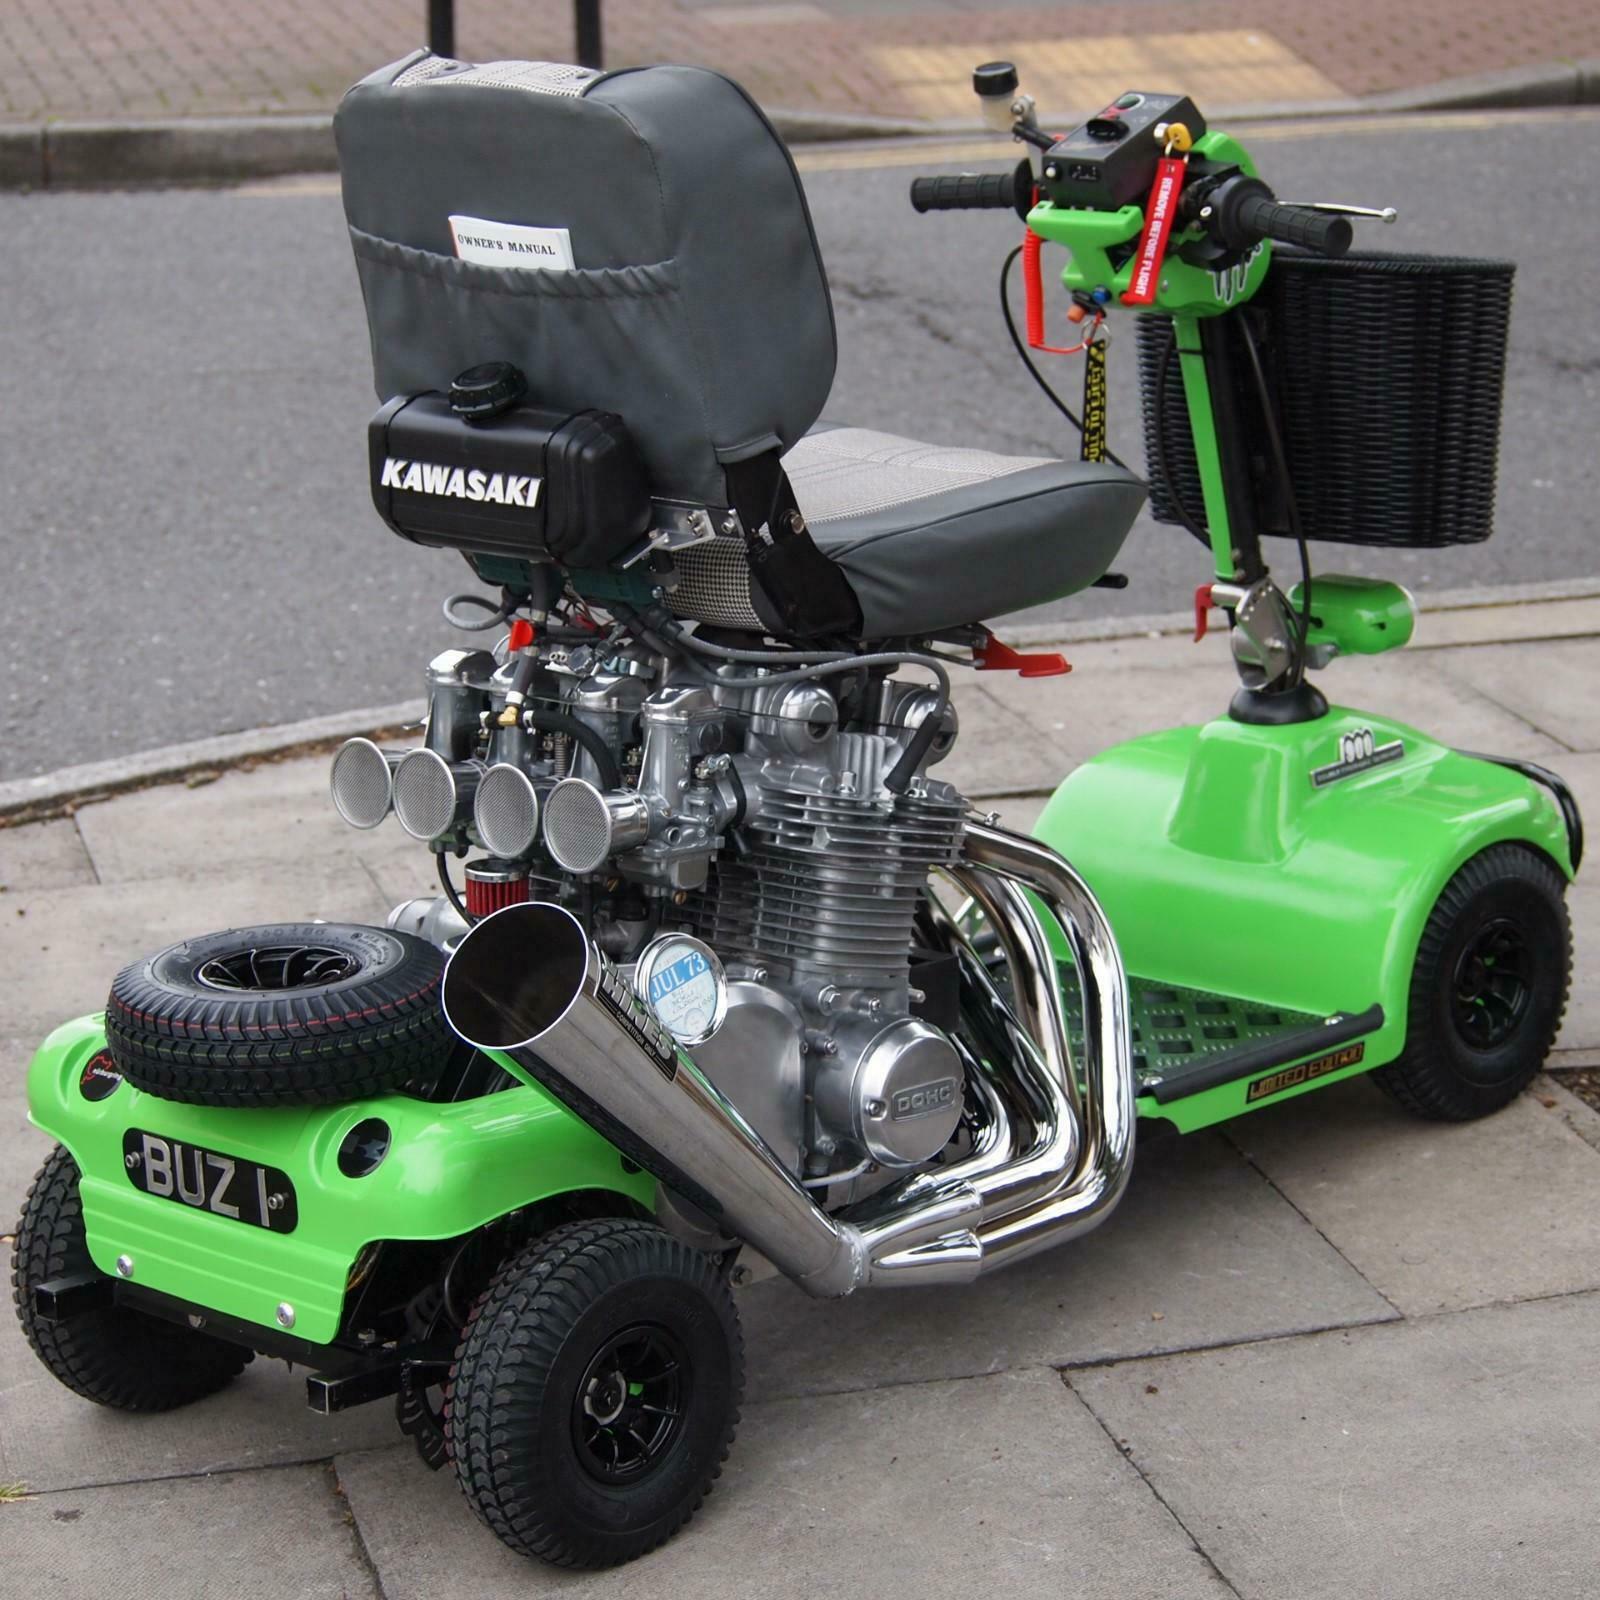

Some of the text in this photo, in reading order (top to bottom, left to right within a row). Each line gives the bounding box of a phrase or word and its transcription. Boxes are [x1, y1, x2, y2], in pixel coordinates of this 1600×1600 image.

[457, 234, 556, 256] OWNER'S MANUAL
[1134, 177, 1173, 296] REMOVE BEFORE FLIGHT
[1088, 367, 1101, 462] ULL TO EJECT
[380, 457, 544, 508] KAWASAKI
[651, 966, 685, 999] JUL
[684, 951, 706, 977] 73
[1248, 1043, 1363, 1100] LIMITED EDITION
[897, 1085, 951, 1113] DOHC
[142, 1134, 240, 1219] BUZ
